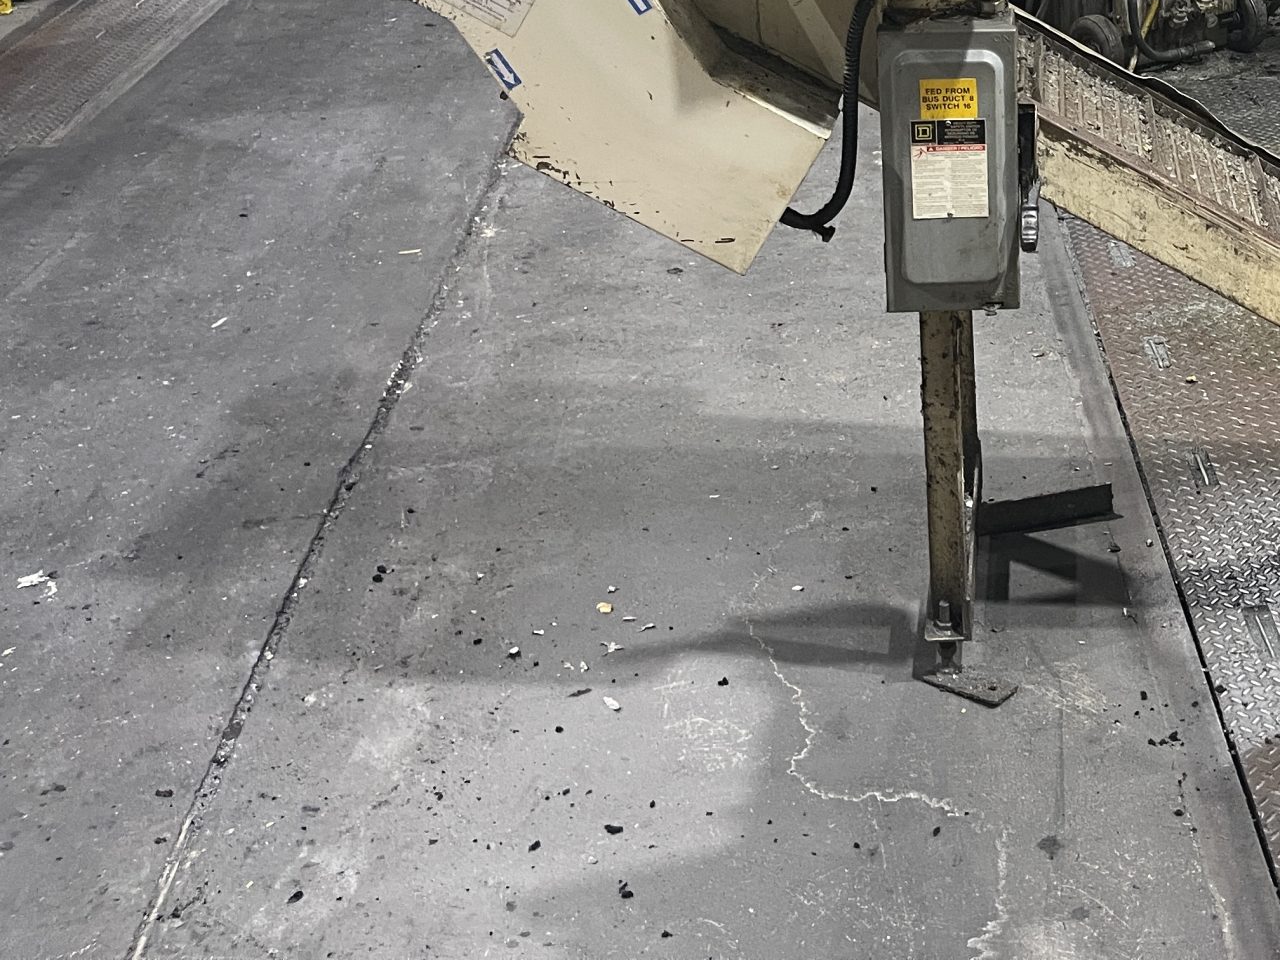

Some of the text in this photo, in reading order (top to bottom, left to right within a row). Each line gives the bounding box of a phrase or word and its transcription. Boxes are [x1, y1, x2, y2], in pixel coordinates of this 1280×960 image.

[925, 87, 970, 96] FED FROM
[942, 95, 965, 103] DUCT
[926, 103, 960, 111] SWITCH
